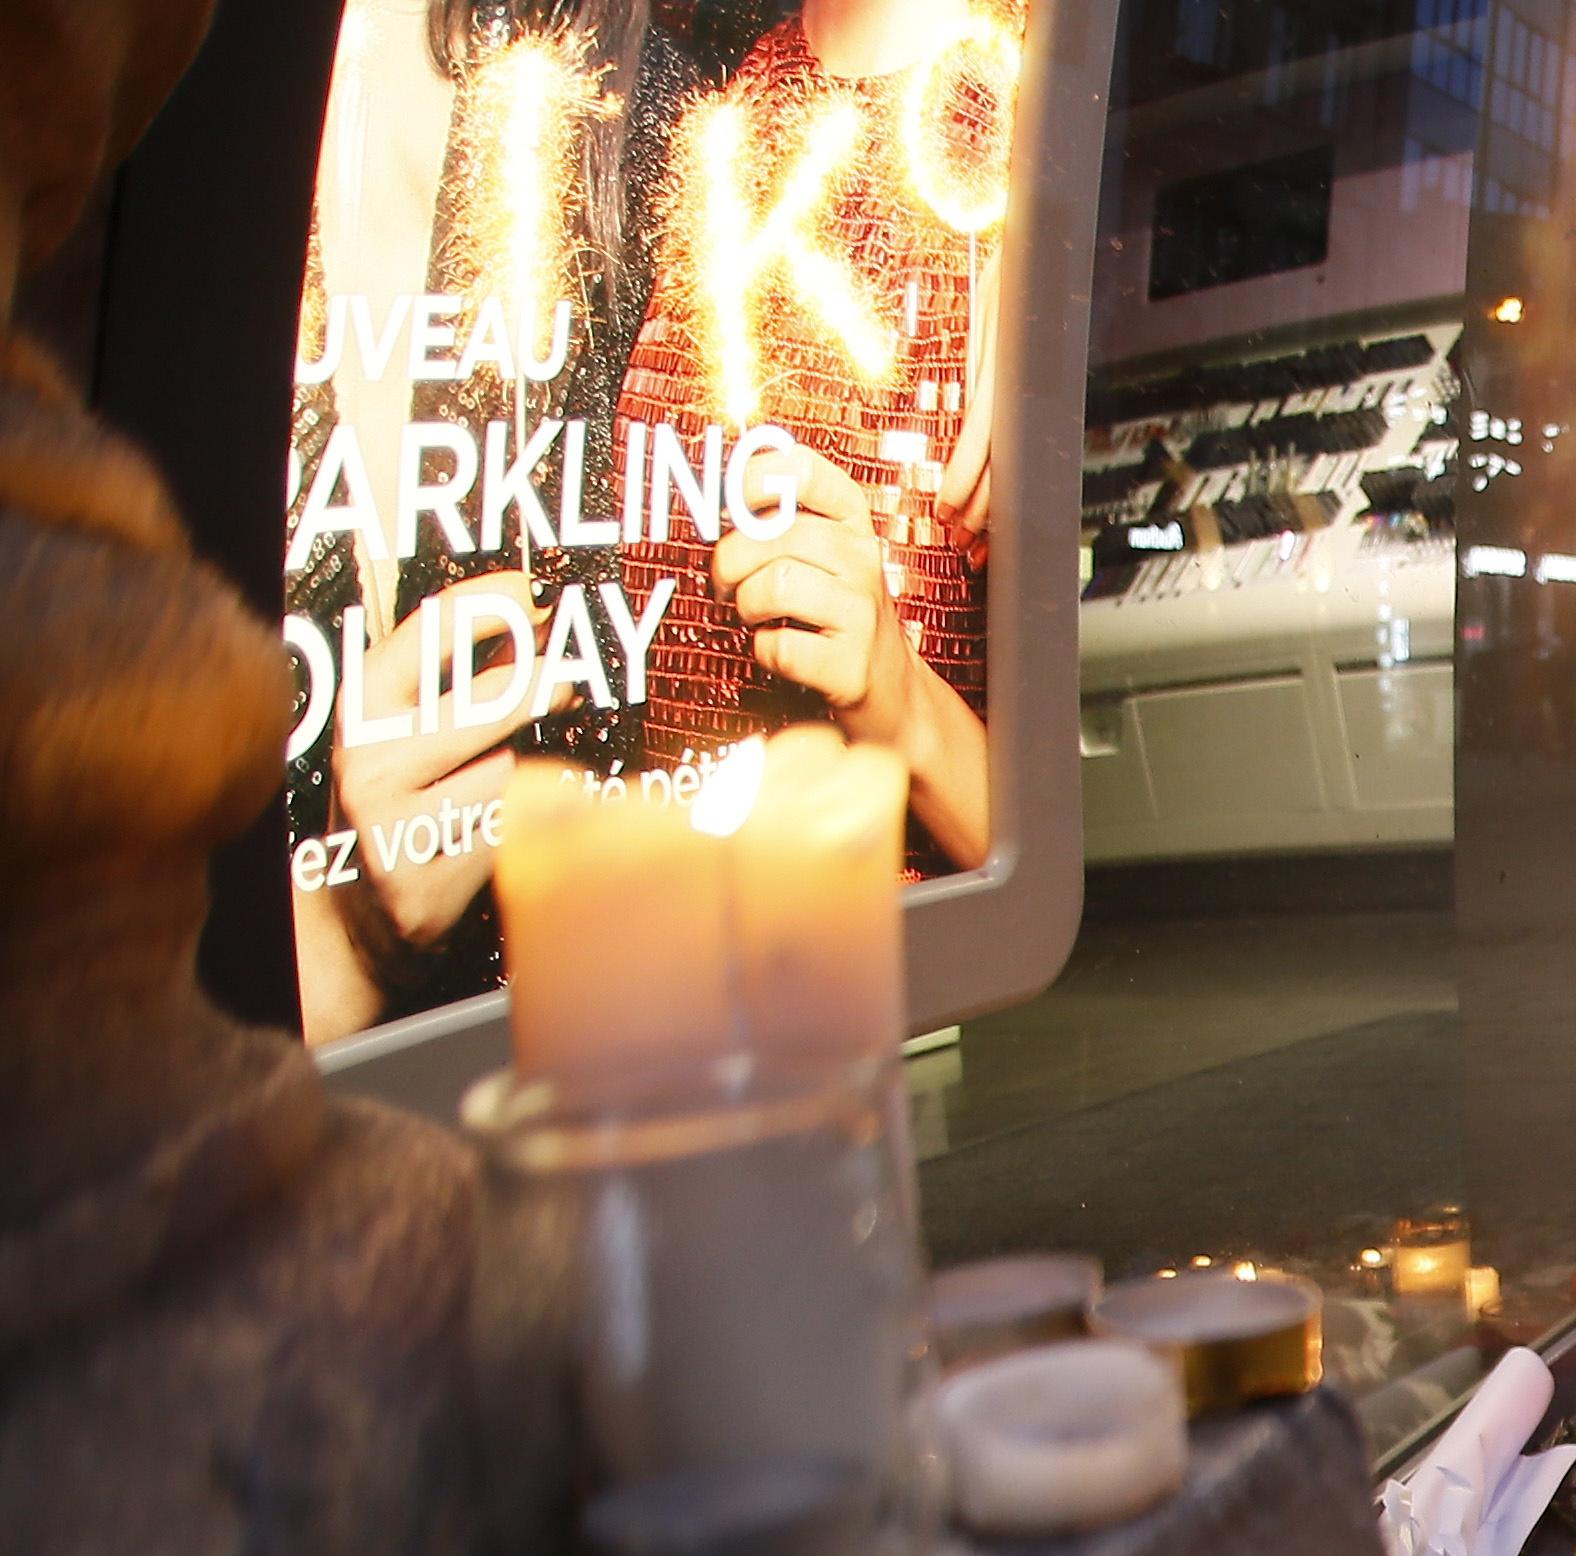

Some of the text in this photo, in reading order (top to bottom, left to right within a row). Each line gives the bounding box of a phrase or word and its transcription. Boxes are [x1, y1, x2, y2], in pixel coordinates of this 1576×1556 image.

[284, 421, 797, 572] ARKLING
[287, 830, 359, 892] ez
[372, 797, 505, 873] votre
